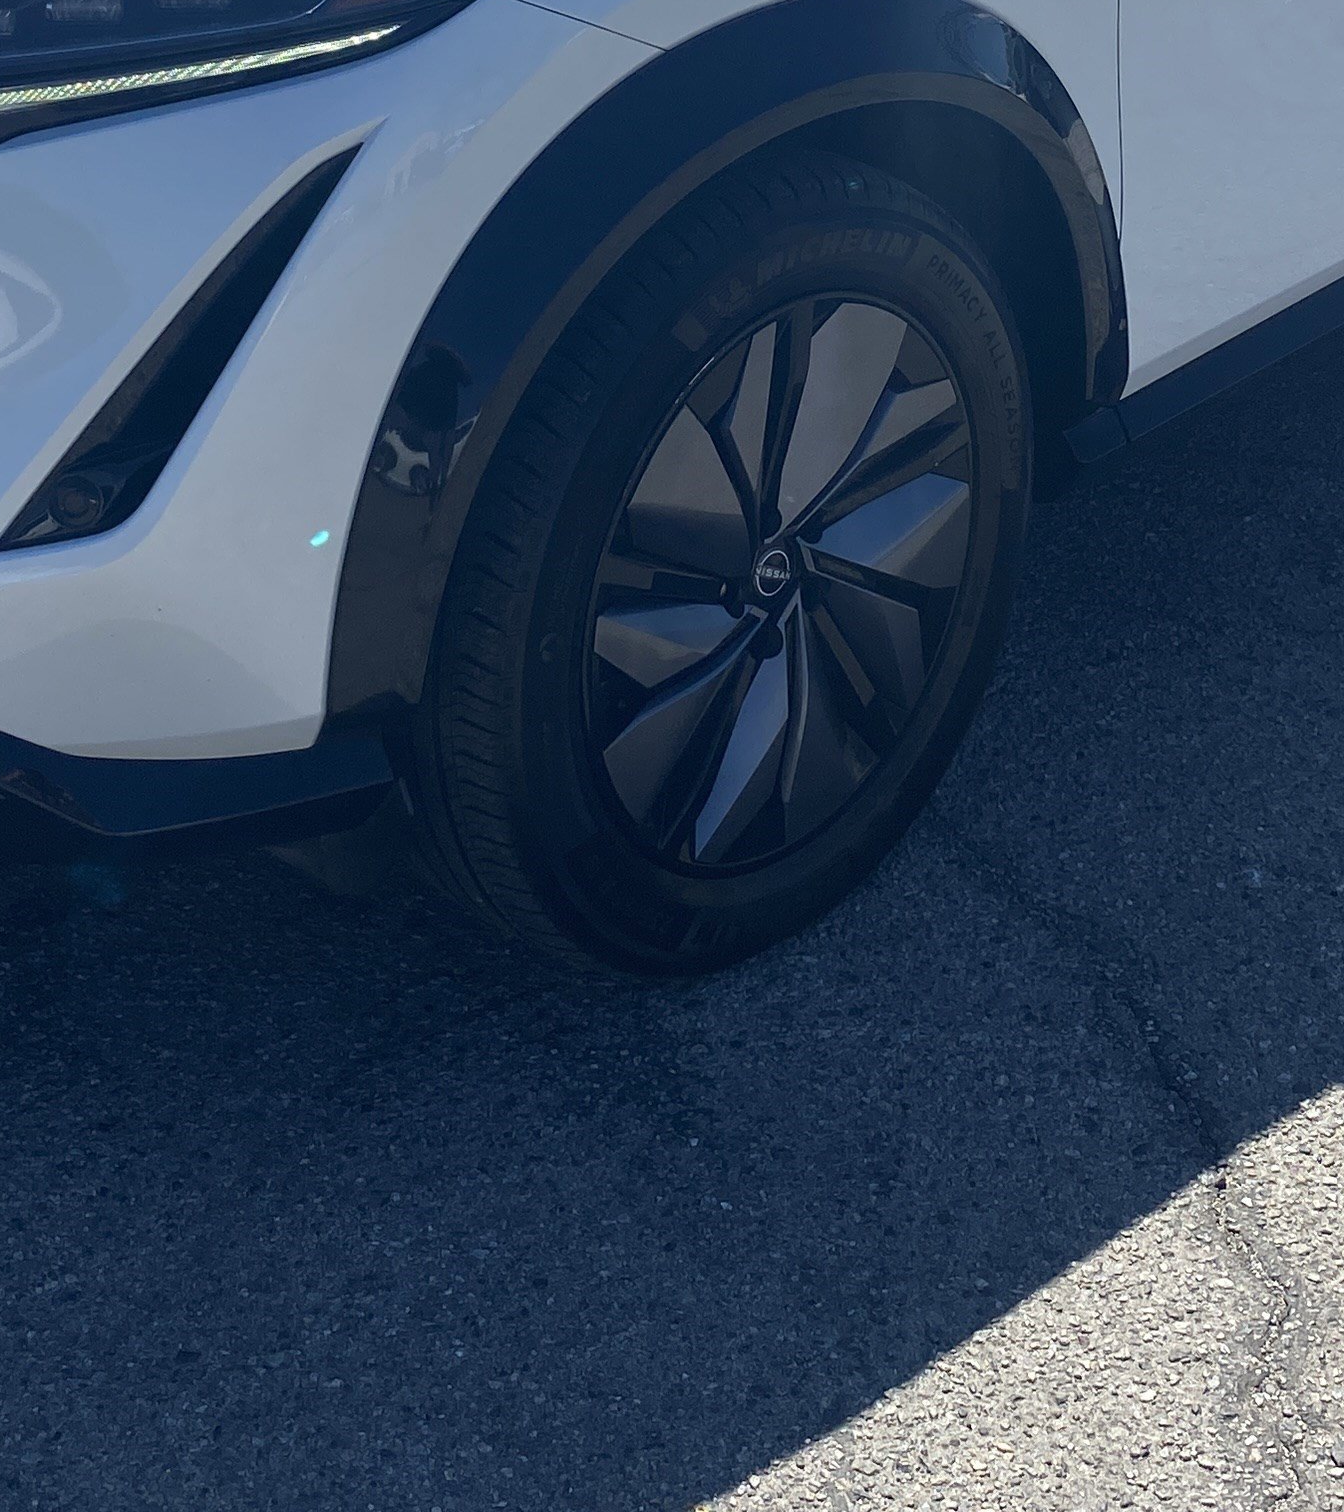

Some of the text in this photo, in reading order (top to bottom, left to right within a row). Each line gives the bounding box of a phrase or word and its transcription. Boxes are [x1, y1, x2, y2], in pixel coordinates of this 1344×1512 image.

[927, 253, 987, 322] PRIMACY
[982, 329, 1007, 370] ALL
[756, 565, 792, 581] NISSAN
